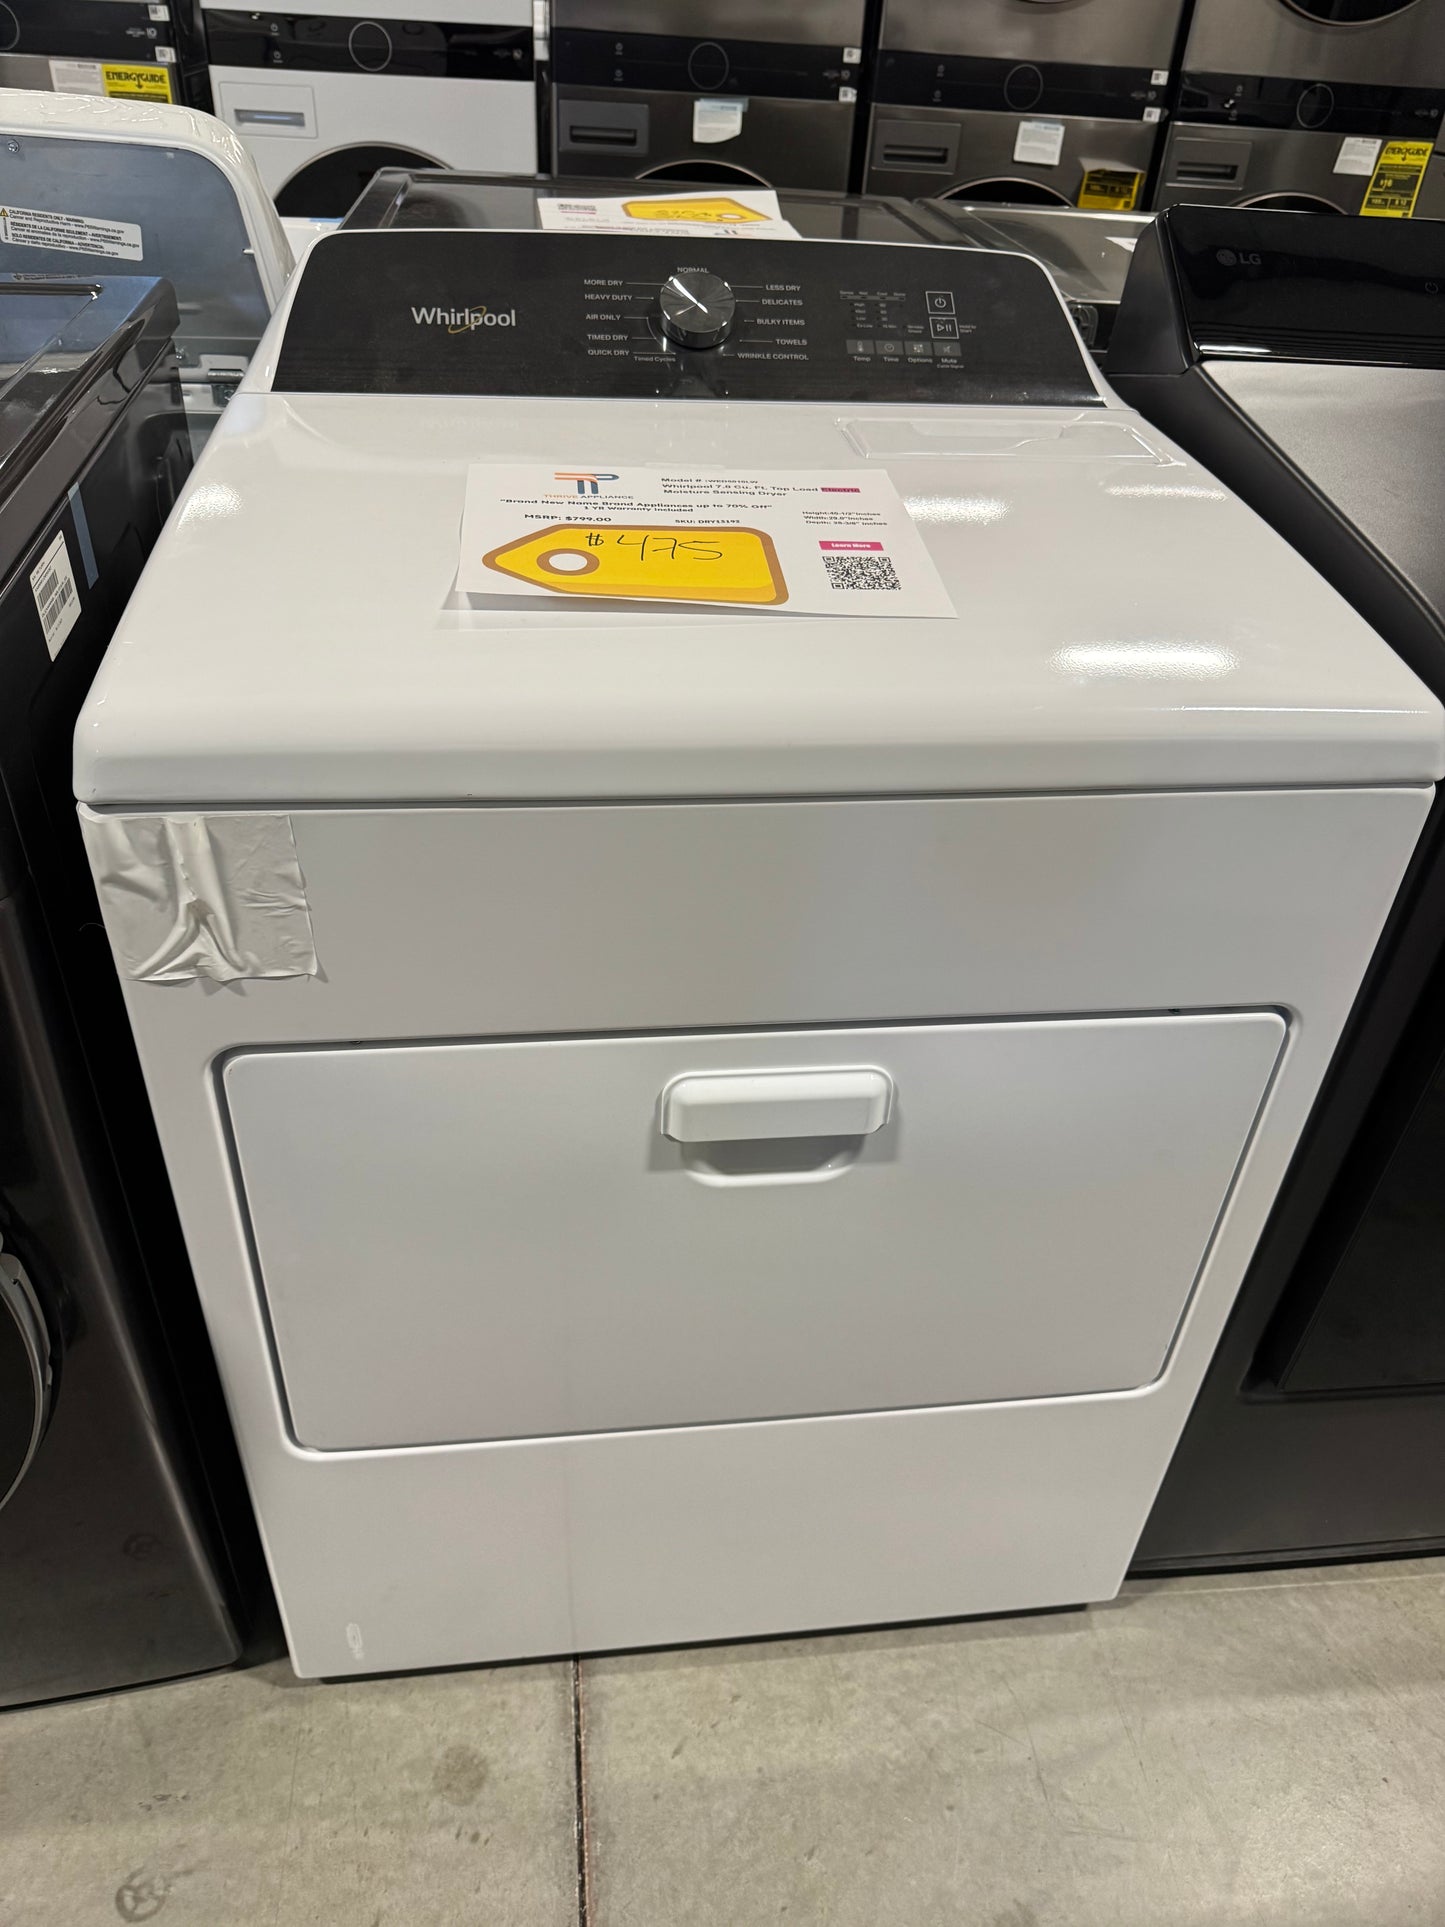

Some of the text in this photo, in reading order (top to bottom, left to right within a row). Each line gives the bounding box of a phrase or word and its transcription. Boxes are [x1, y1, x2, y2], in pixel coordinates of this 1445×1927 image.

[1239, 252, 1262, 265] LG
[677, 266, 710, 274] NORMAL
[411, 306, 516, 331] Whirlpool
[757, 318, 781, 326] BULKY
[612, 334, 629, 342] DRY
[776, 338, 808, 346] TOWELS
[588, 349, 630, 357] QUICK DRY
[634, 355, 677, 364] Timed Cycles
